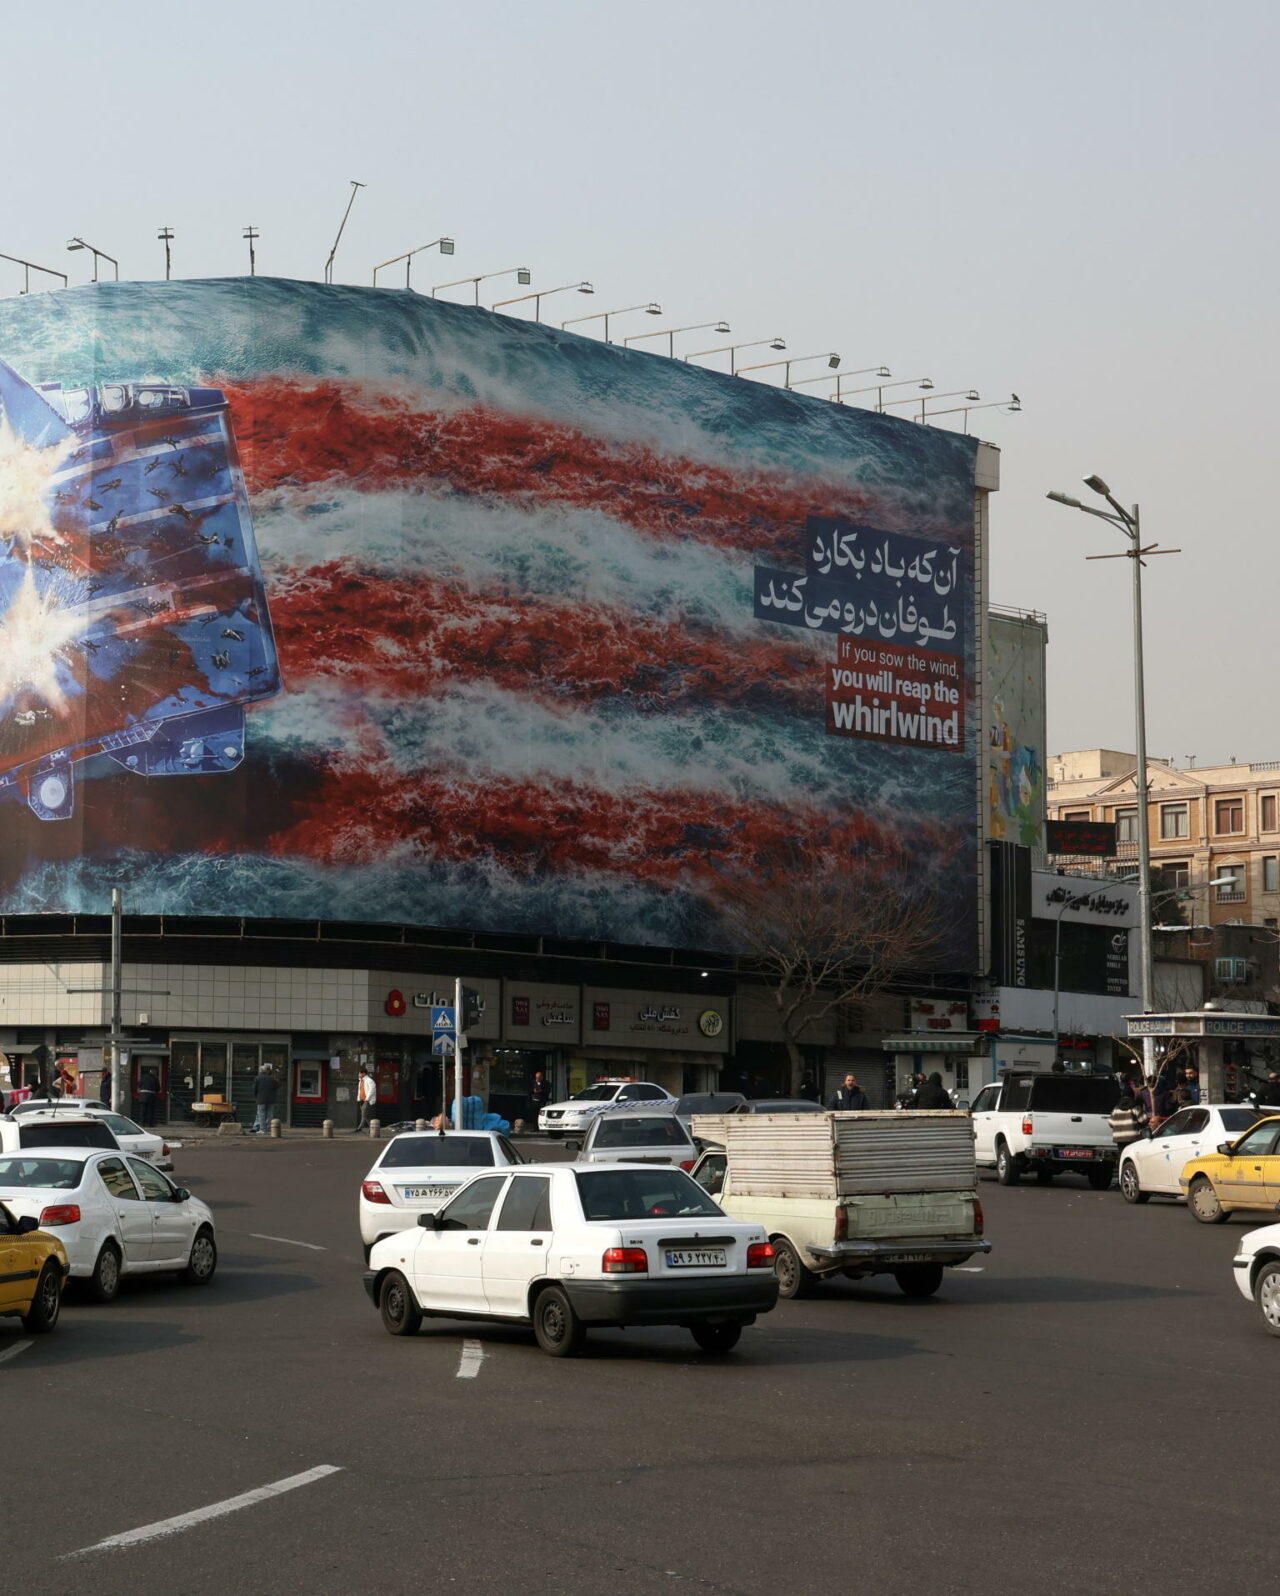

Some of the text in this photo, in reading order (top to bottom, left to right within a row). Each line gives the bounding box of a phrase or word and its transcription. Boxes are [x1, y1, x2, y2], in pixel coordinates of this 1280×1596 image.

[812, 529, 865, 580] بکارد
[871, 541, 906, 588] باد
[878, 595, 956, 646] طوفان
[842, 642, 959, 679] If you sow the wind,
[832, 669, 958, 704] you will reap the
[832, 696, 958, 744] whirlwind
[1089, 898, 1095, 911] و
[1095, 895, 1114, 913] موبایل
[1114, 898, 1129, 915] مرکز
[1016, 919, 1026, 986] SAMSUNG
[640, 1006, 681, 1022] کفش ملی
[1129, 1021, 1150, 1032] POLICE
[1207, 1021, 1244, 1033] POLICE
[673, 1253, 684, 1264] ۵۹
